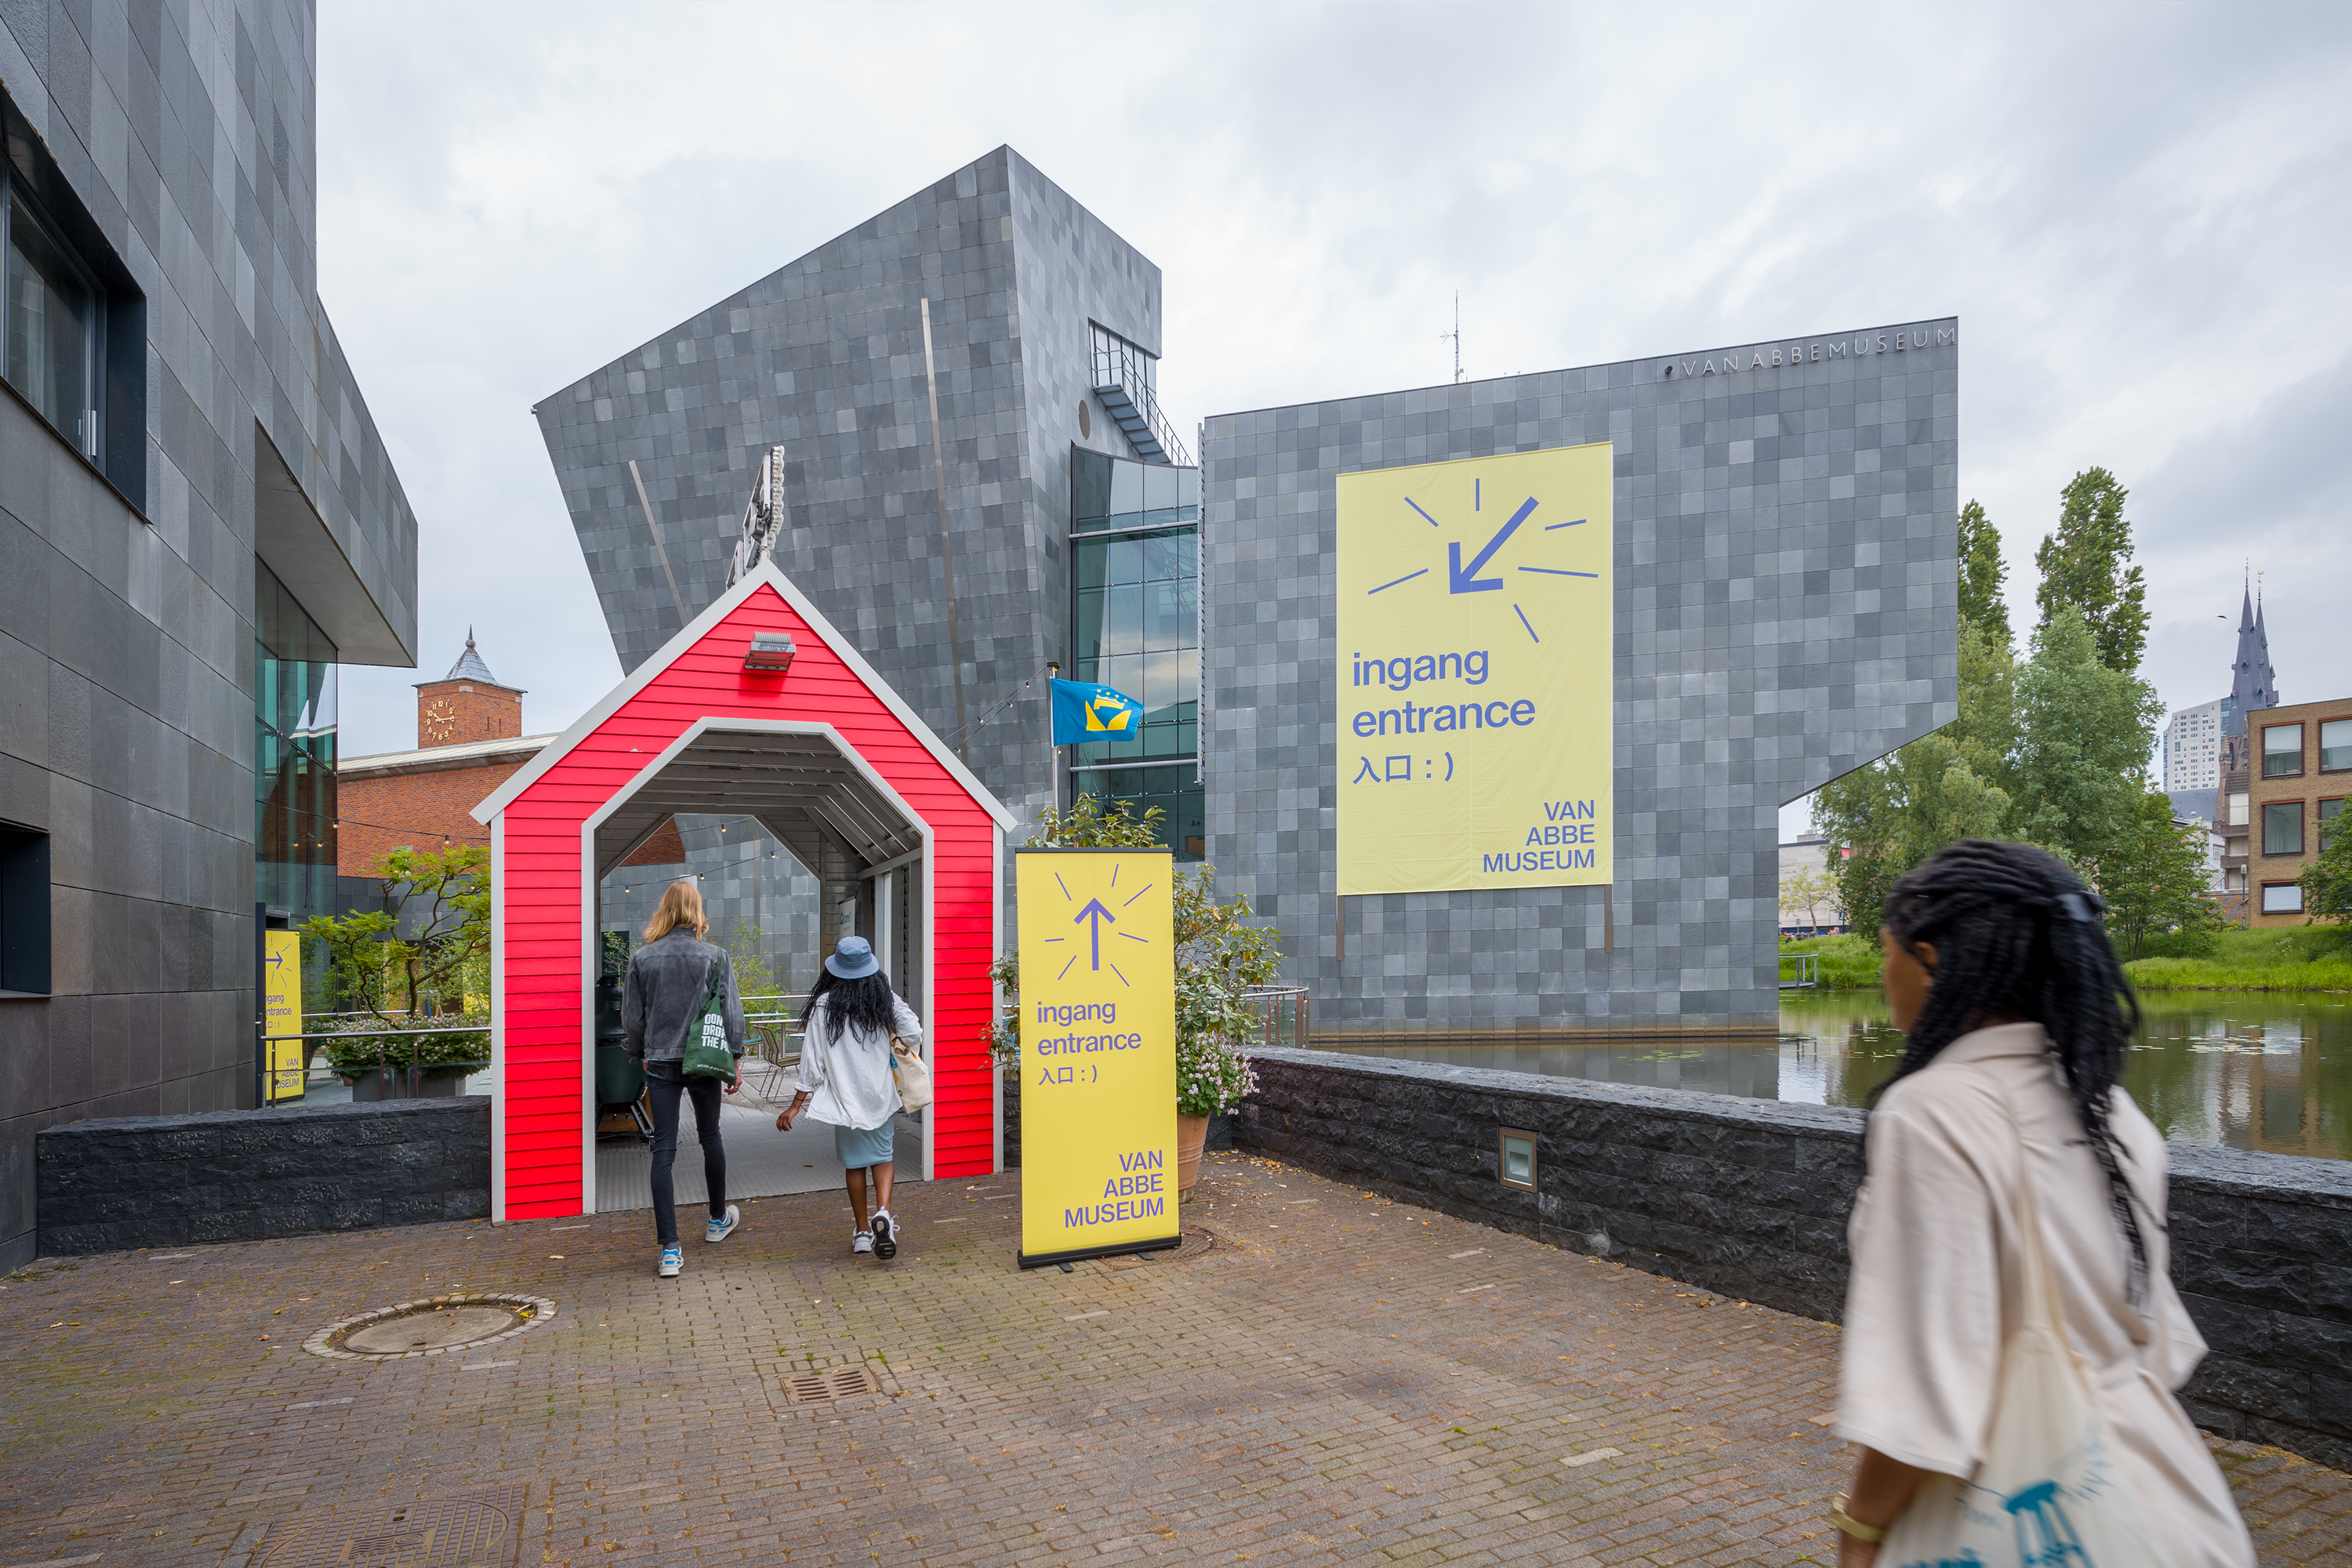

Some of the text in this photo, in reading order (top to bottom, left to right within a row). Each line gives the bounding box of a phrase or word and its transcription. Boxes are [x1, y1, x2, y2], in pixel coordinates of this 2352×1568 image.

[1682, 328, 1955, 377] VAN ABBEMUSEUM
[1353, 650, 1489, 691] ingang
[1352, 699, 1536, 738] entrance
[1352, 755, 1411, 785] 入口
[1543, 799, 1595, 822] VAN
[1525, 824, 1595, 847] ABBE
[1483, 849, 1595, 873] MUSEUM
[266, 995, 284, 1004] ngang
[266, 1007, 292, 1016] ntrance
[1037, 1000, 1116, 1027] ingang
[702, 1036, 730, 1054] THE M
[1037, 1033, 1142, 1056] entrance
[281, 1068, 299, 1077] ABBE
[285, 1058, 299, 1066] VAN
[271, 1078, 299, 1089] USEUM
[1038, 1066, 1073, 1086] 入口
[1118, 1149, 1163, 1173] VAN
[1103, 1173, 1163, 1199] ABBE
[1065, 1196, 1163, 1229] MUSEUM
